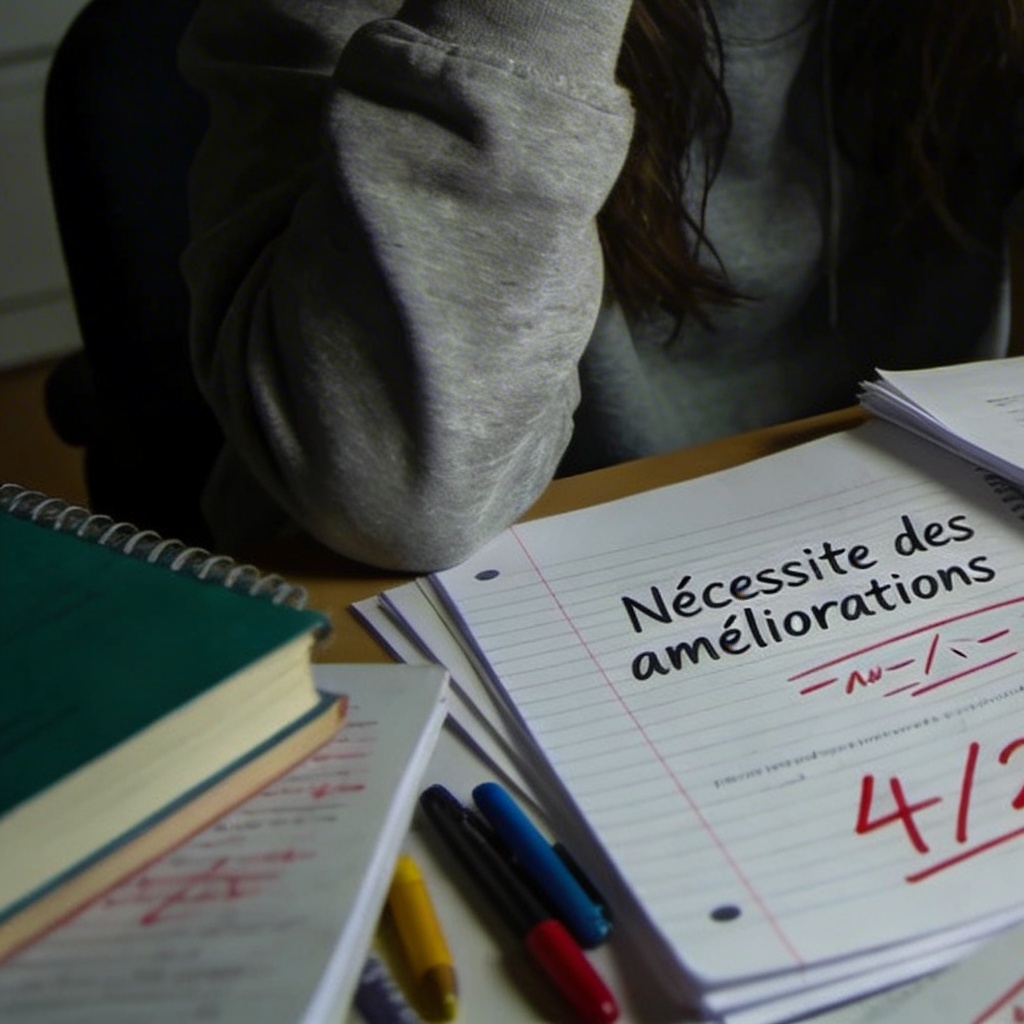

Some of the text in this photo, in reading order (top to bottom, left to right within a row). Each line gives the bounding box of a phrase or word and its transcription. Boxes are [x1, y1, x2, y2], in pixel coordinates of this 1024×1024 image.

[621, 514, 975, 634] Nécessite des
[631, 555, 997, 681] améliorations
